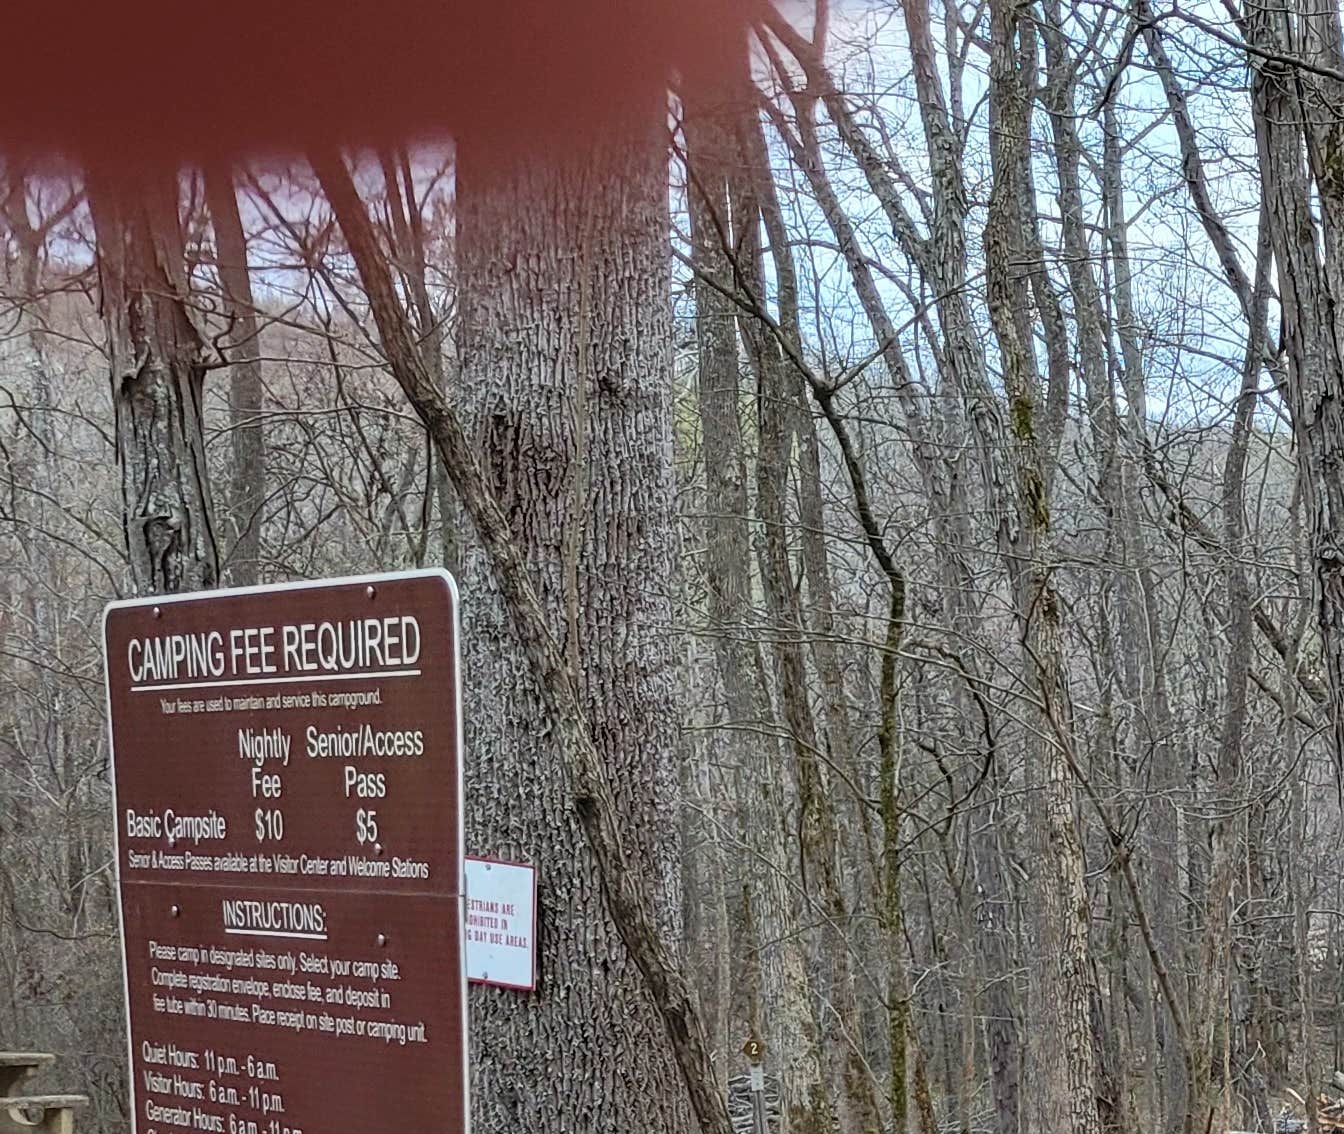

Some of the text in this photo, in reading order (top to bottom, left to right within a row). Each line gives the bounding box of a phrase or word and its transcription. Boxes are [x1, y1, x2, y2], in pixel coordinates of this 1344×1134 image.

[128, 616, 420, 682] CAMPING FEE REQUIRED
[160, 688, 382, 714] Your fees are used to maintain and service this campground.
[238, 727, 291, 766] Nightly
[306, 724, 424, 757] Senior/Access
[252, 767, 281, 797] Fee
[345, 766, 386, 797] Pass
[126, 809, 226, 845] Basic Campsite
[255, 808, 283, 843] $10
[356, 808, 378, 845] $5
[128, 849, 429, 878] Senior & Access Passes available at the Visitor Center and Welcome Stations
[223, 900, 327, 932] INSTRUCTIONS:
[467, 898, 514, 916] ESTRIANS ARE
[468, 914, 508, 931] OHIBITED IN
[475, 930, 487, 942] DAY
[490, 932, 502, 945] USE
[149, 941, 401, 982] Please camp in designated sites only. Select your camp site.
[152, 967, 390, 1010] Complete registration envelope, enclose fee, and deposit in
[153, 993, 428, 1045] fee tube within 30 minutes. Place receipt on site post or camping unit.
[142, 1041, 167, 1065] Quiet
[168, 1044, 200, 1069] Hours:
[204, 1050, 216, 1071] 11
[218, 1056, 240, 1077] p.m.
[247, 1055, 254, 1078] 6
[257, 1061, 279, 1080] a.m.
[751, 1042, 758, 1054] 2
[143, 1070, 172, 1092] Visitor
[173, 1074, 205, 1099] Hours:
[209, 1080, 217, 1102] 6
[218, 1086, 240, 1105] a.m.
[249, 1086, 259, 1109] 11
[262, 1092, 285, 1115] p.m.
[145, 1100, 191, 1128] Generator
[193, 1107, 225, 1133] Hours:
